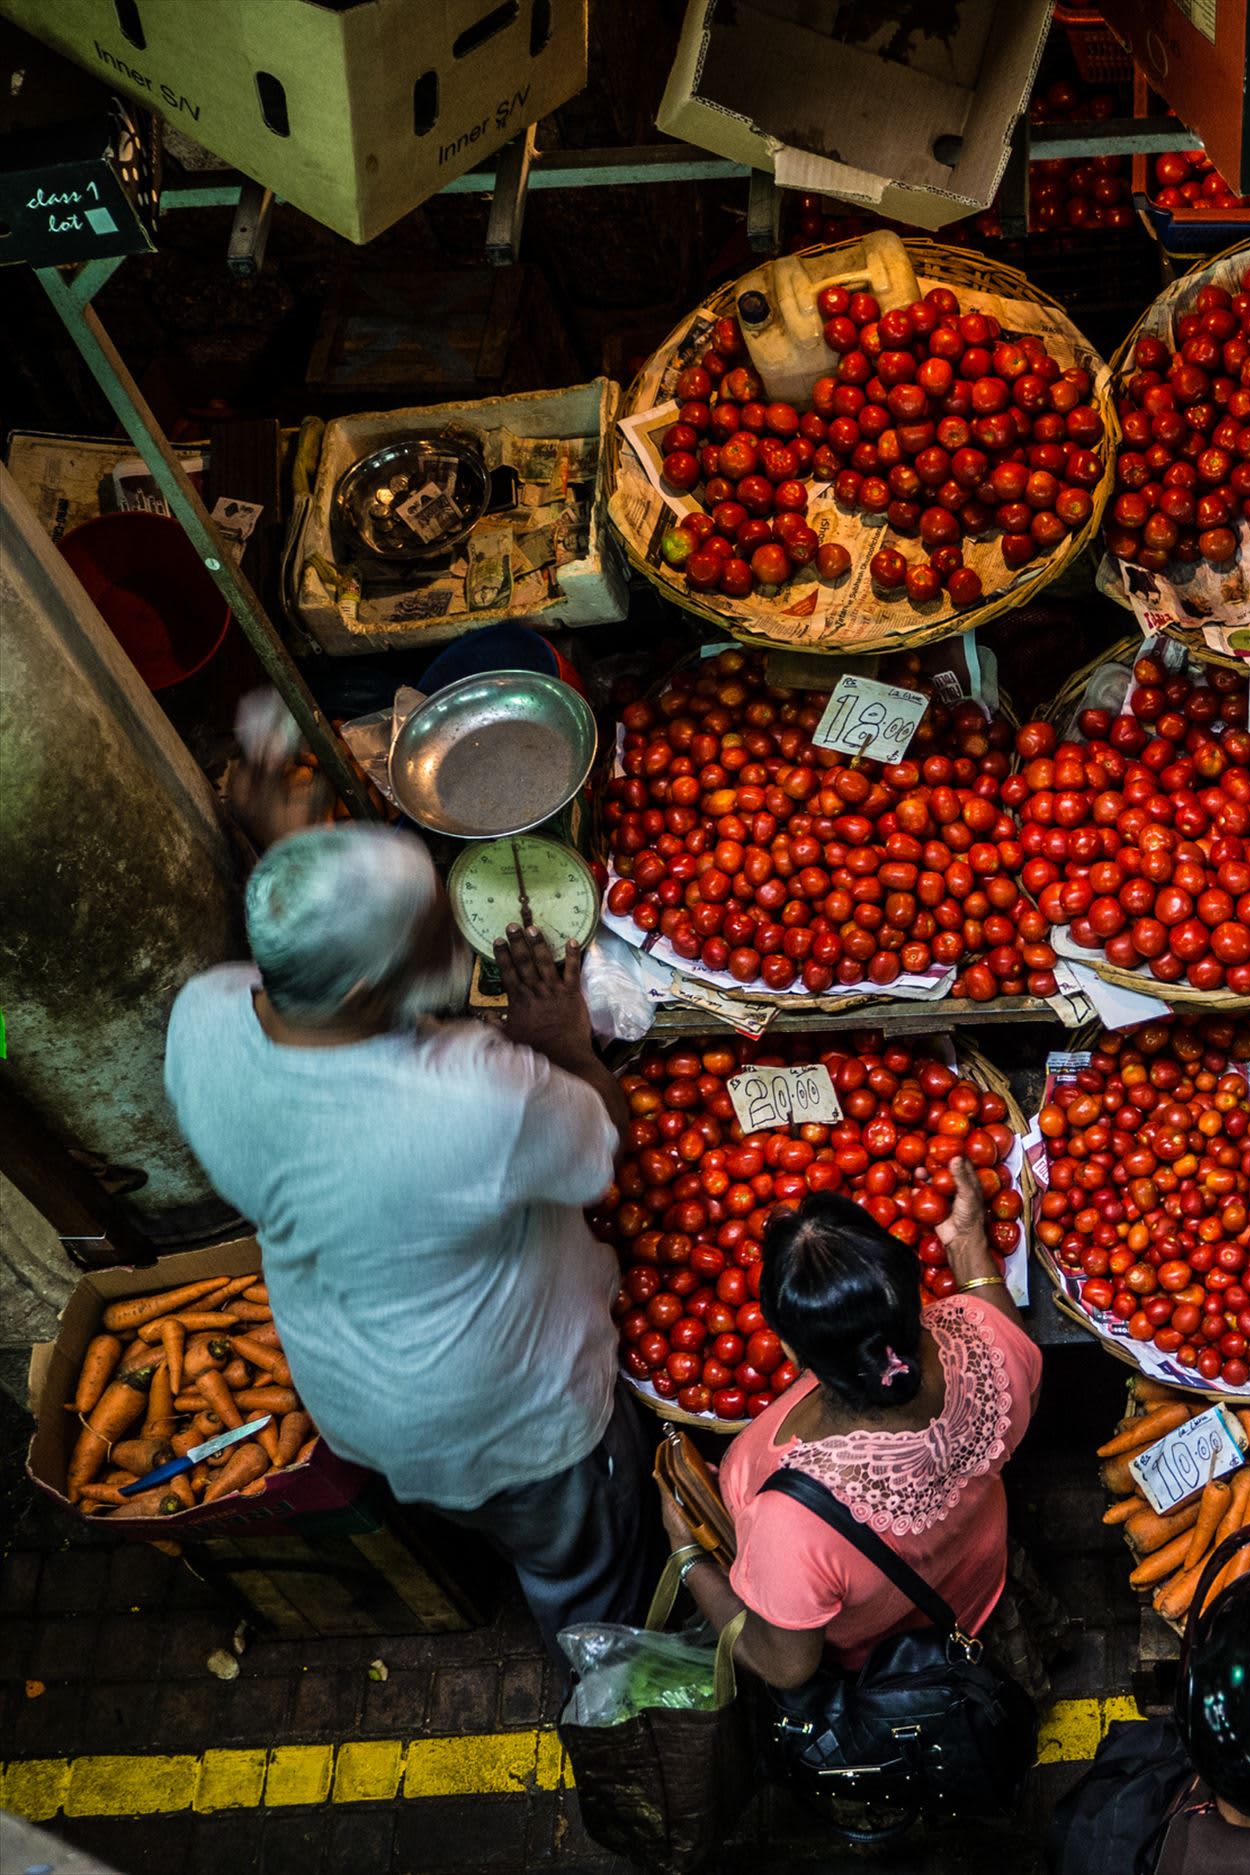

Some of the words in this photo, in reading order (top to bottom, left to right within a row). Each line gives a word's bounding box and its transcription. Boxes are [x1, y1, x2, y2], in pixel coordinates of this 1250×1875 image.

[94, 40, 152, 92] Inner
[439, 116, 490, 165] Inner
[26, 187, 83, 209] class
[86, 180, 100, 201] 1
[48, 213, 84, 233] lot
[823, 694, 915, 749] 18.00
[744, 1075, 820, 1128] 20.00
[1151, 1430, 1223, 1502] 10.00
